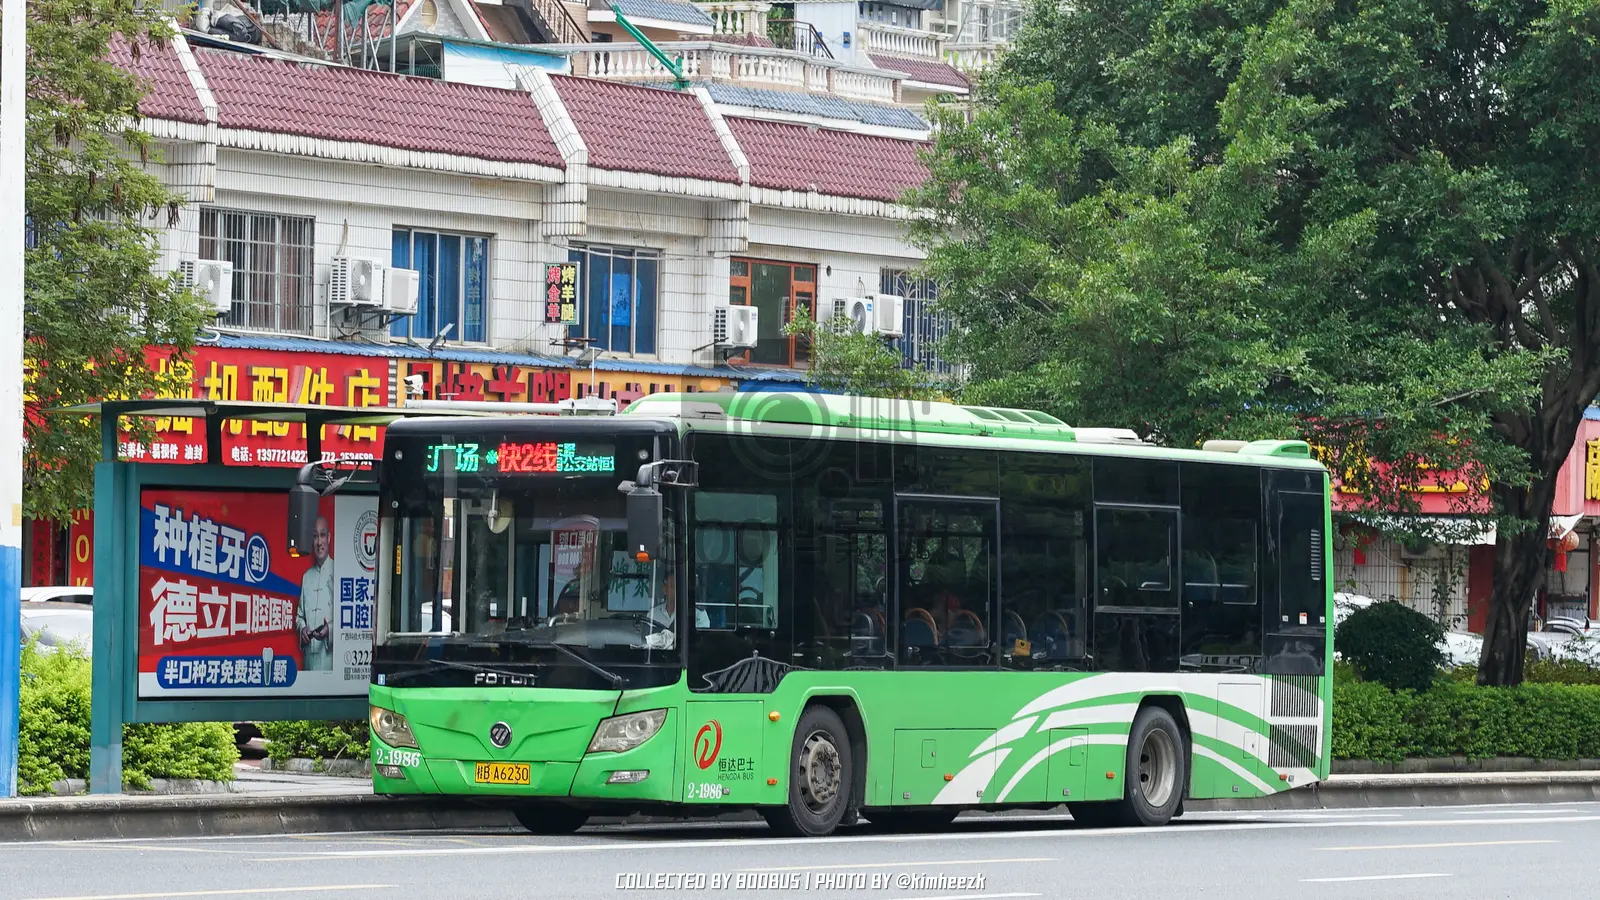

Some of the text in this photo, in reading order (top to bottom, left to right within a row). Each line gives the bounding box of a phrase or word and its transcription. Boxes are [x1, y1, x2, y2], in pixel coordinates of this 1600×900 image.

[340, 576, 375, 602] 国家
[150, 577, 293, 646] 德立口腔医院
[340, 604, 374, 629] 口腔
[376, 748, 421, 768] 2-1986
[718, 757, 755, 772] 恒达巴士
[742, 772, 754, 780] BUS
